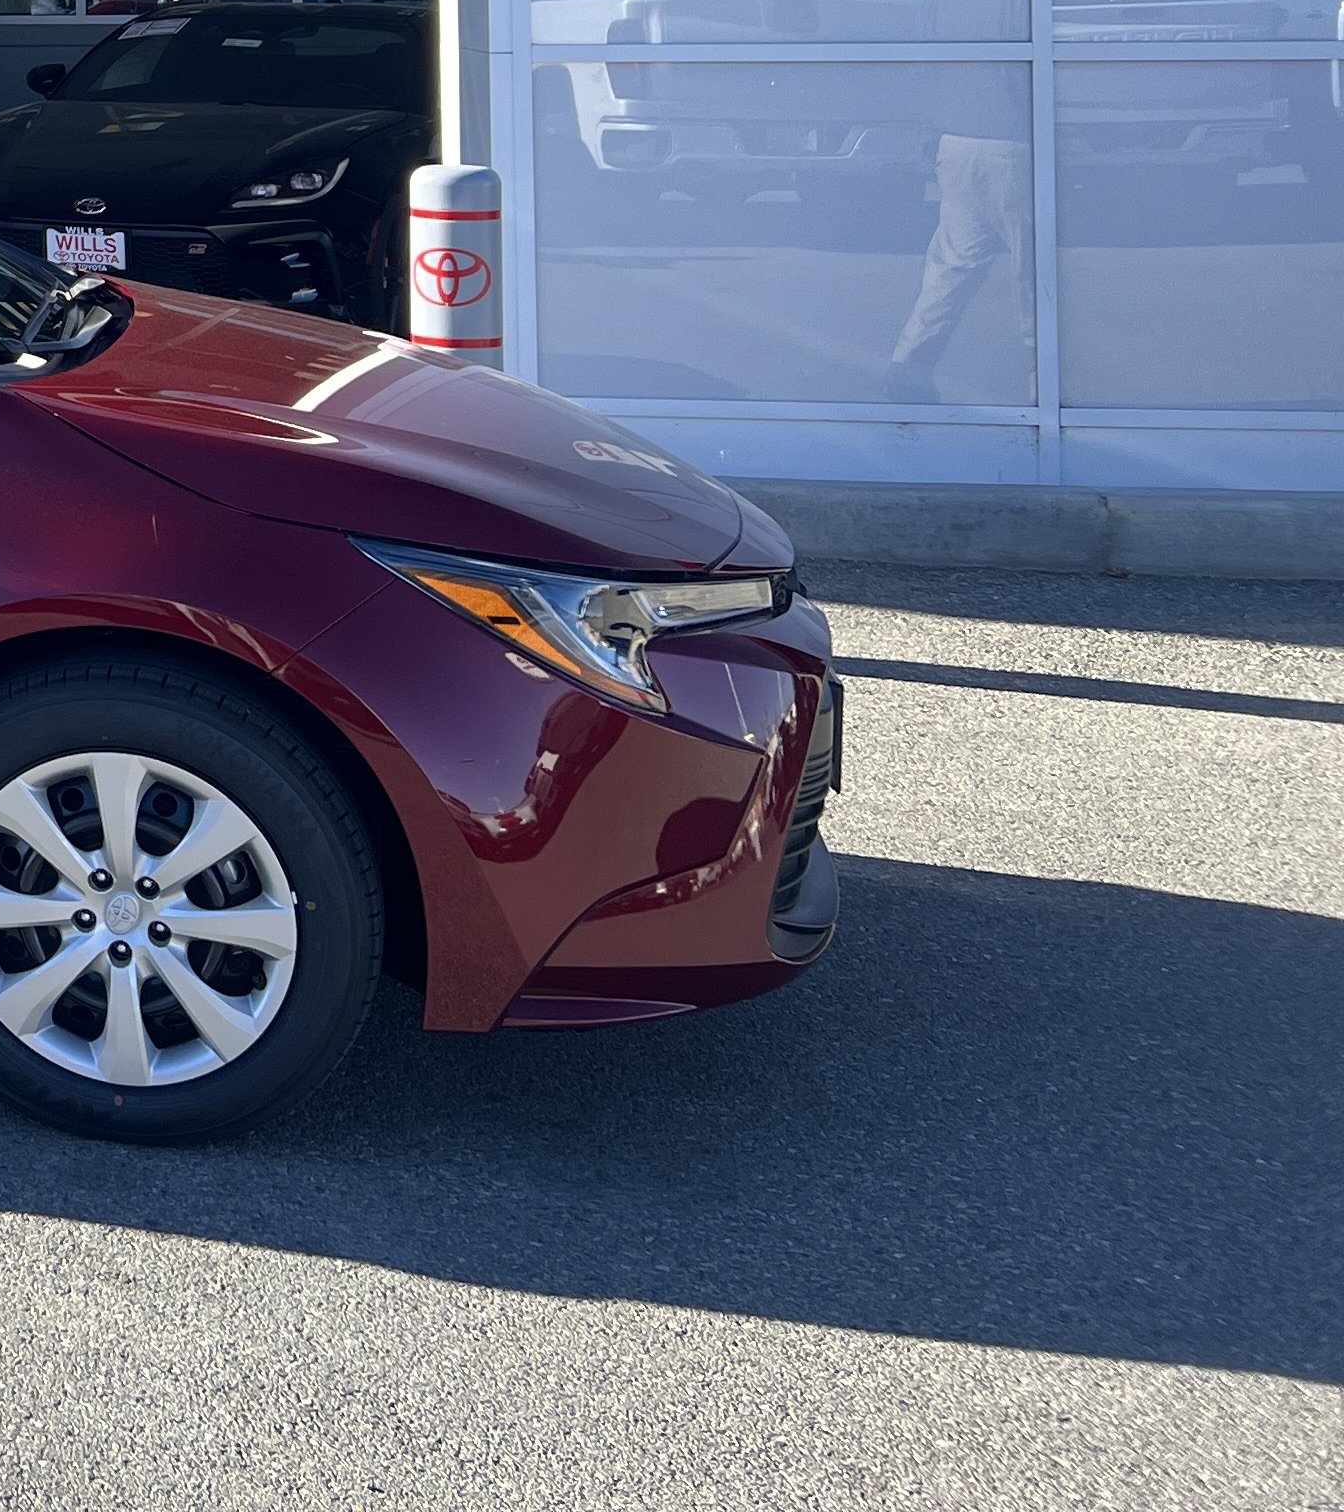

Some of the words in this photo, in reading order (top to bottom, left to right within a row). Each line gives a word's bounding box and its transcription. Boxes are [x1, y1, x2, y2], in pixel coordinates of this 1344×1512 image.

[65, 226, 104, 235] WILLS
[55, 235, 117, 253] WILLS
[71, 252, 120, 264] TOYOTA
